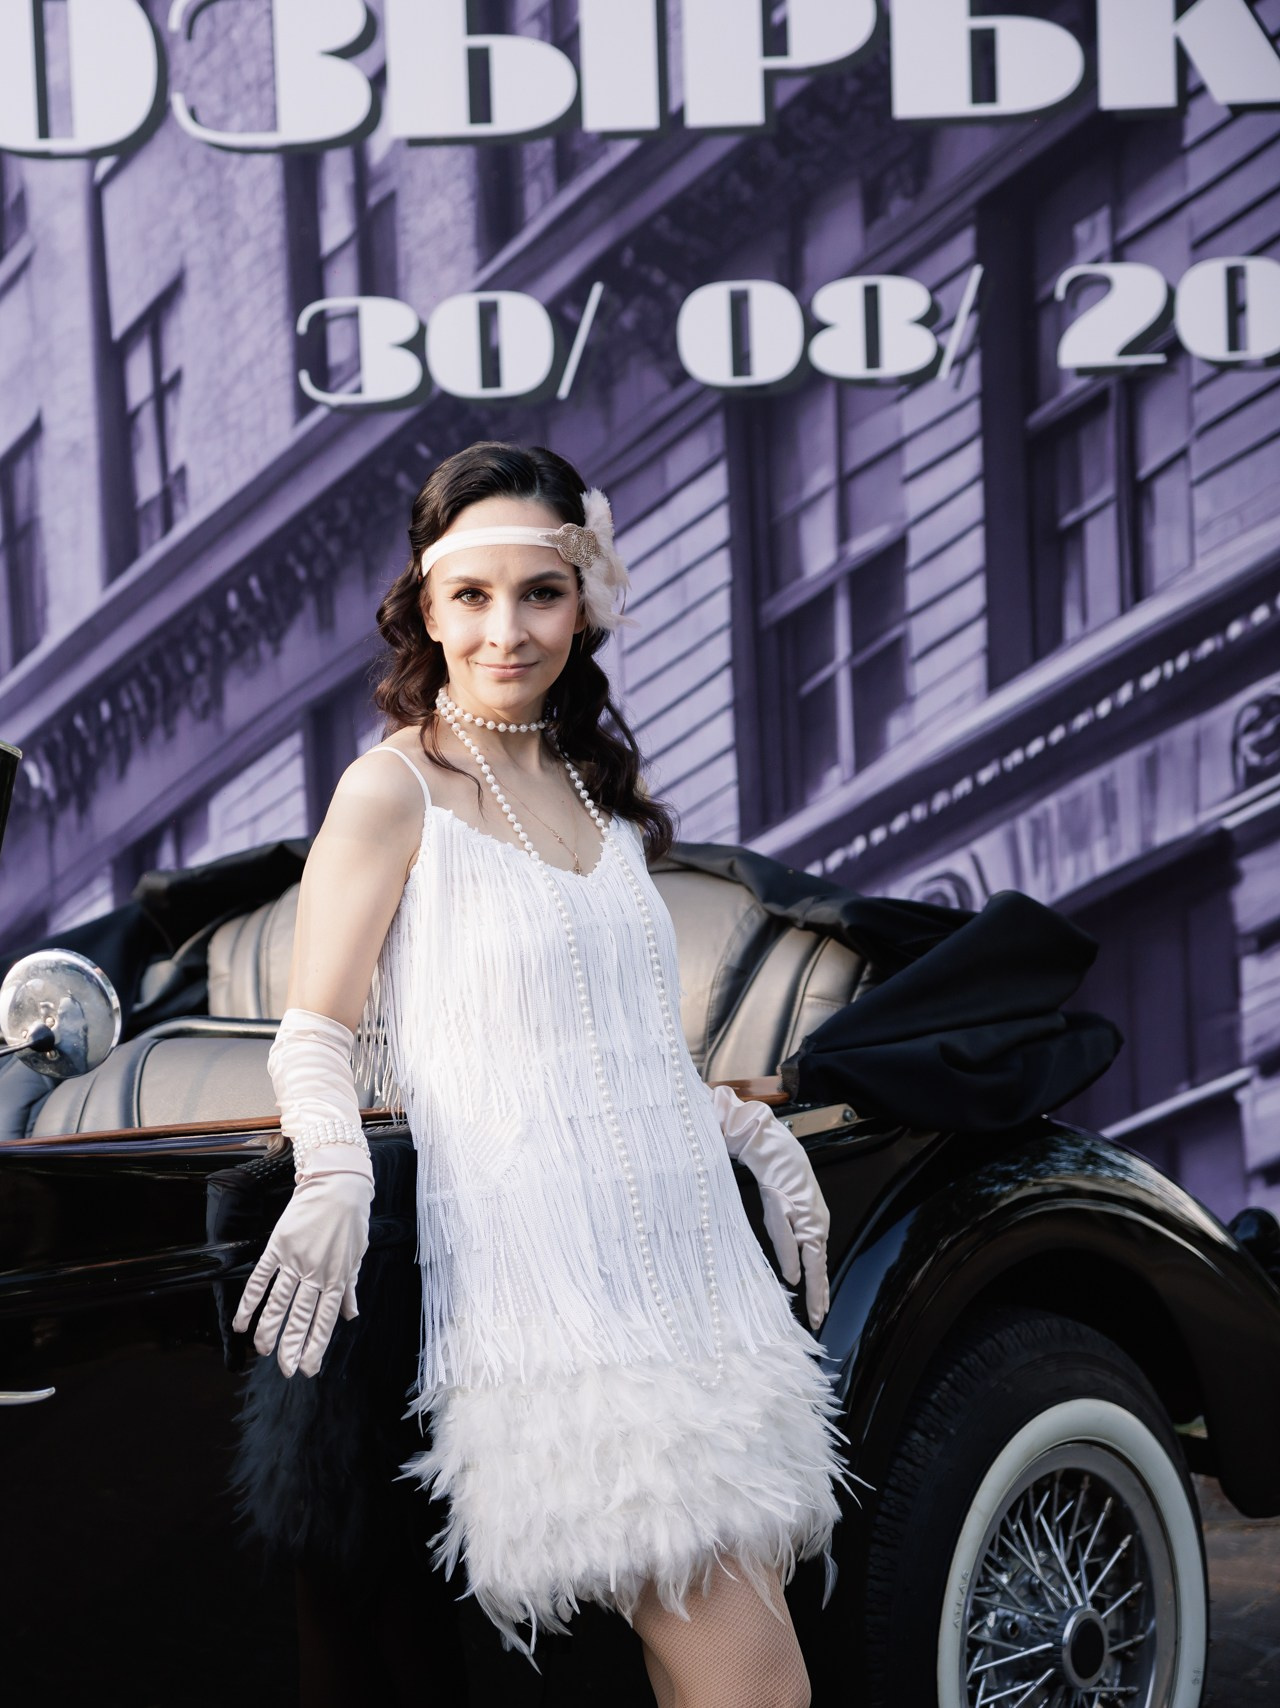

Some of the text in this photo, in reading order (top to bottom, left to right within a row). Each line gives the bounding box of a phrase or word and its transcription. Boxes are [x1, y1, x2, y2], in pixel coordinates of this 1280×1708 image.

[297, 256, 1280, 404] 30/ 08/ 20
